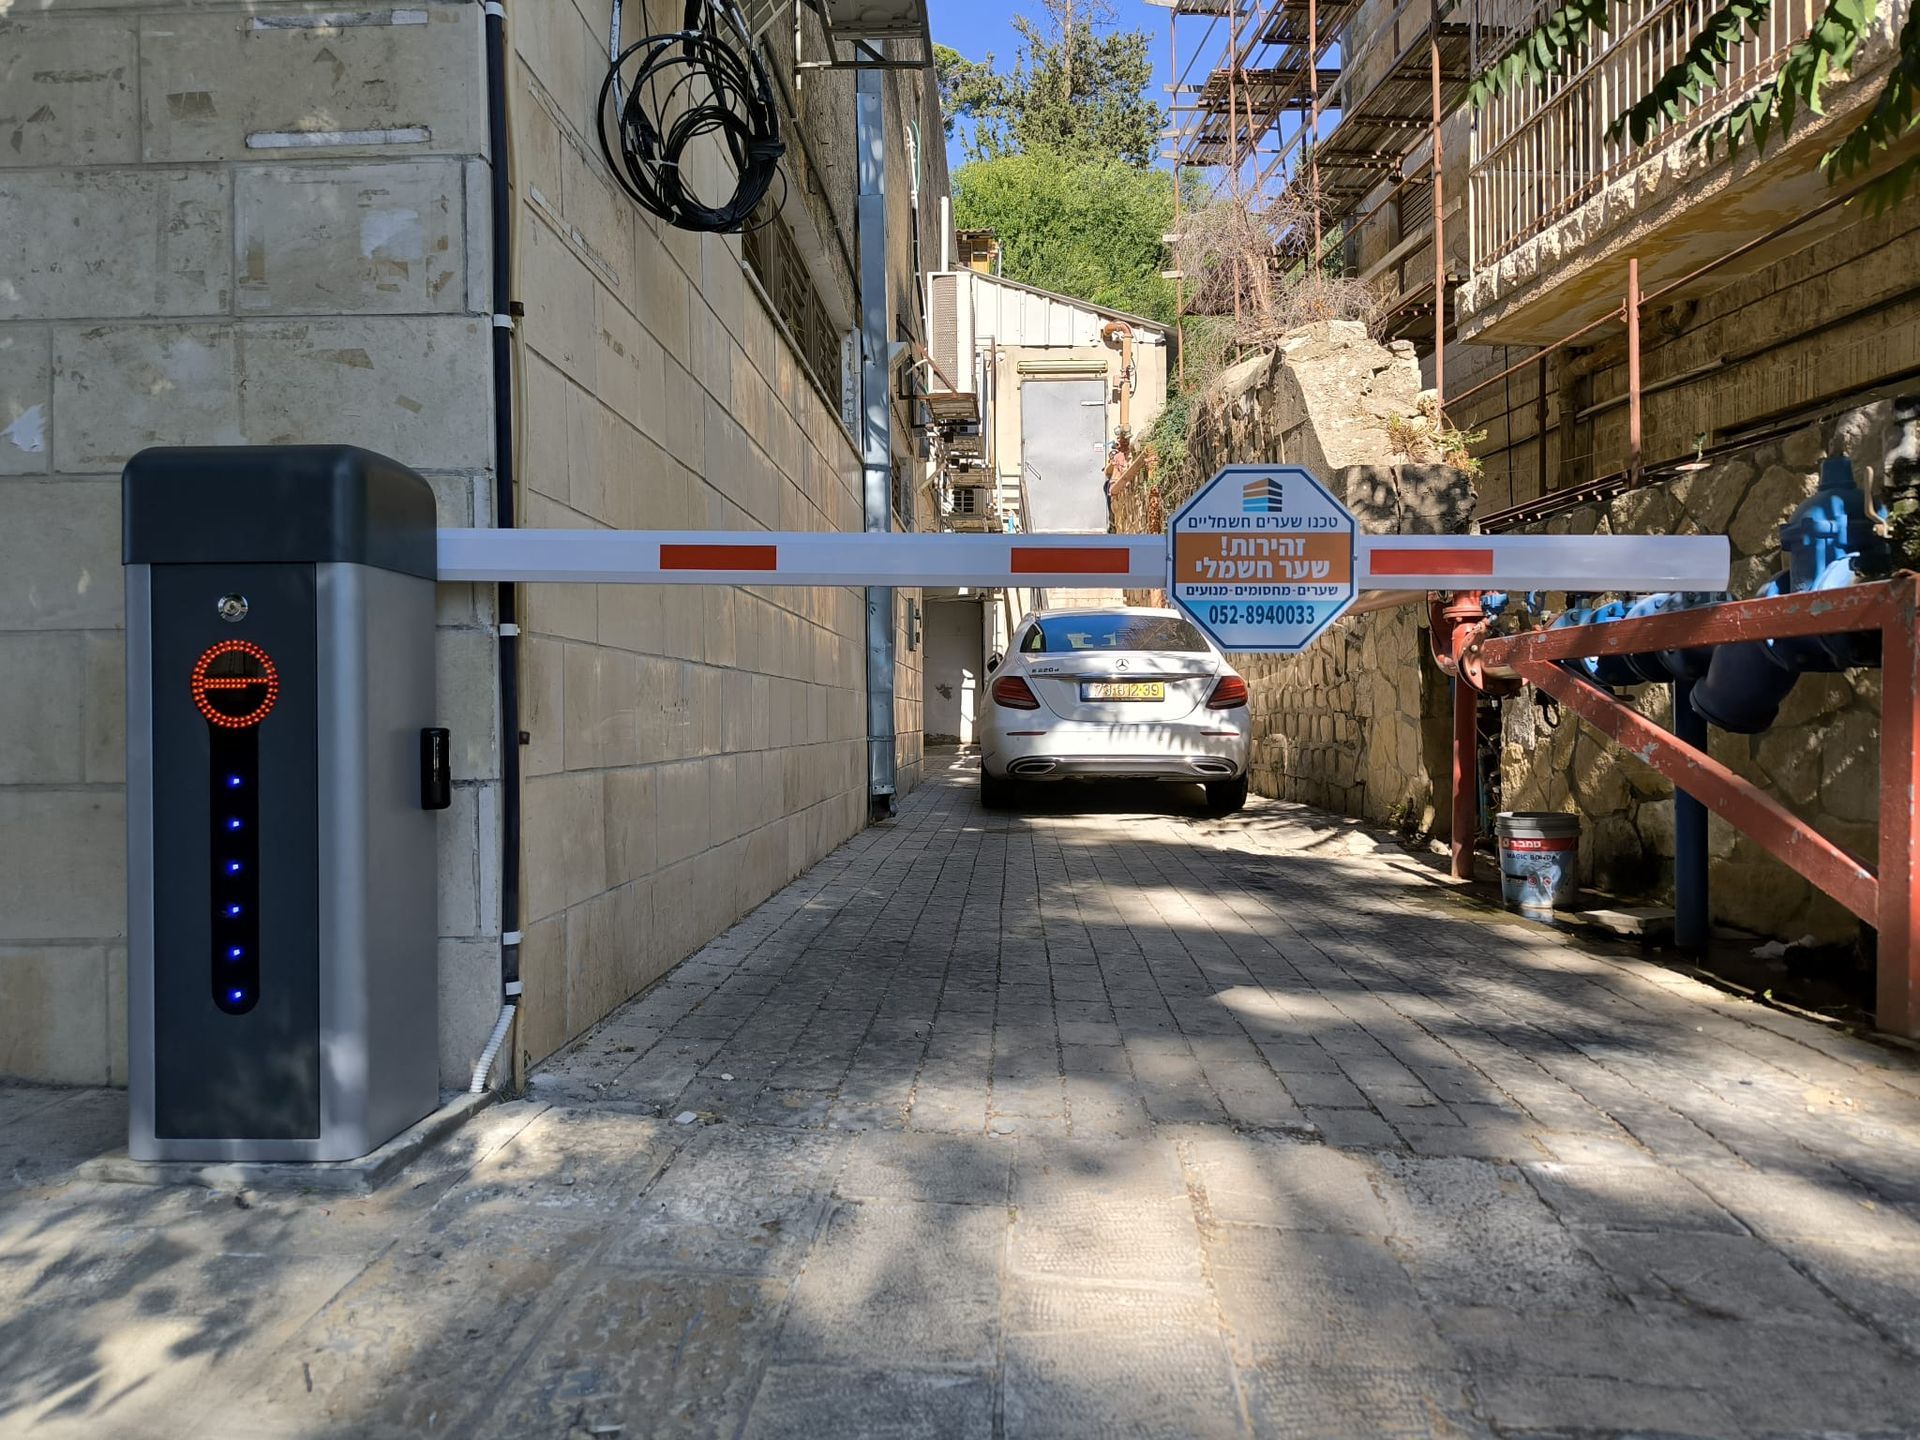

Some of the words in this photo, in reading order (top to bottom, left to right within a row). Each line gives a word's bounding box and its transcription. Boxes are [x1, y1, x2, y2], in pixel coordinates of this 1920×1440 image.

[1188, 515, 1250, 529] חשמליים
[1256, 516, 1302, 528] שערים
[1308, 516, 1338, 528] טכנו
[1221, 535, 1306, 557] זהירות!
[1195, 557, 1273, 579] חשמלי
[1279, 560, 1330, 579] שער
[1208, 604, 1315, 625] 052-8940033
